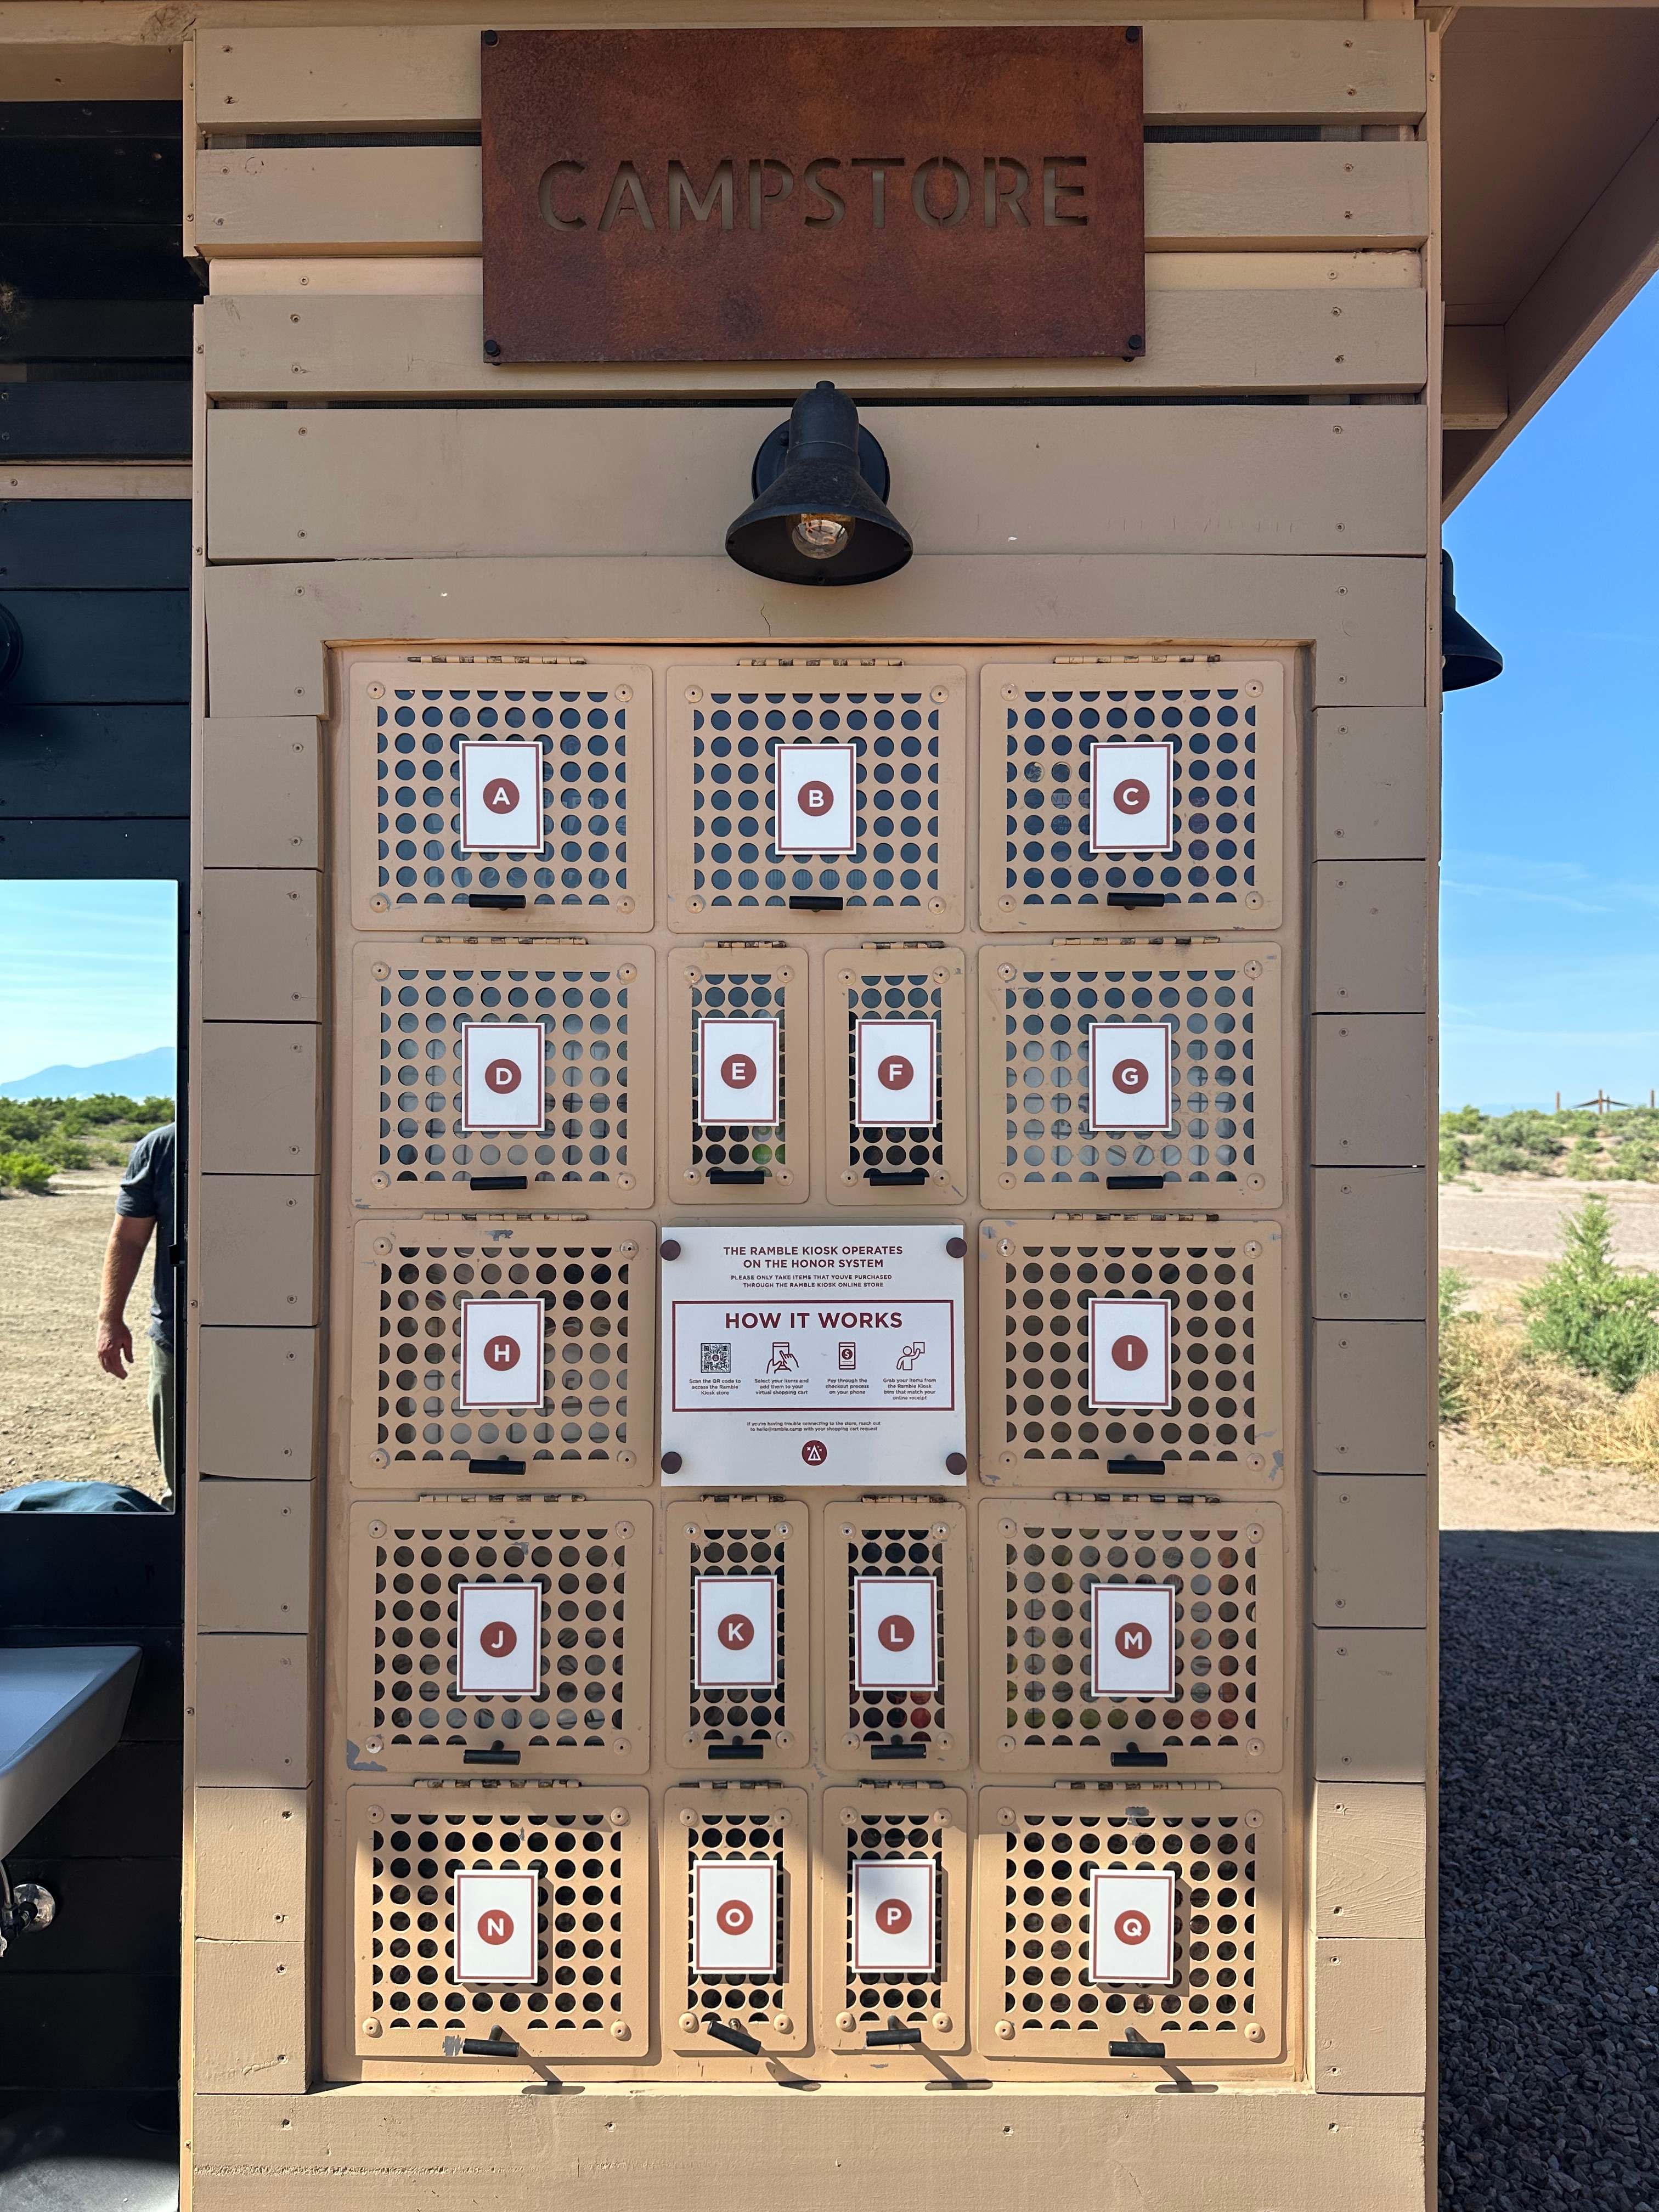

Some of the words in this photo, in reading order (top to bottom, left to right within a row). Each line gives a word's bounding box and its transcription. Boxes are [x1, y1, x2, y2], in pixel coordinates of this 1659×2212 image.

[537, 156, 1088, 232] CAMPSTORE
[492, 787, 511, 805] A
[809, 789, 824, 808] B
[1122, 787, 1139, 806] C
[496, 1067, 512, 1085] D
[732, 1063, 746, 1080] E
[889, 1064, 903, 1081] F
[1121, 1067, 1138, 1086] G
[723, 1246, 746, 1255] THE
[750, 1246, 799, 1255] RAMBLE
[802, 1246, 838, 1255] KIOSK
[842, 1246, 903, 1255] OPERATES
[743, 1259, 761, 1268] ON
[764, 1259, 788, 1268] THE
[792, 1259, 835, 1268] HONOR
[838, 1259, 883, 1268] SYSTEM
[726, 1312, 782, 1329] HOW
[790, 1312, 810, 1329] IT
[817, 1312, 902, 1329] WORKS
[494, 1344, 510, 1362] H
[491, 1630, 504, 1649] J
[729, 1623, 744, 1641] K
[890, 1624, 904, 1643] L
[1124, 1632, 1143, 1650] M
[725, 1908, 745, 1927] O
[887, 1908, 902, 1926] P
[487, 1918, 504, 1937] N
[1122, 1918, 1142, 1937] Q
